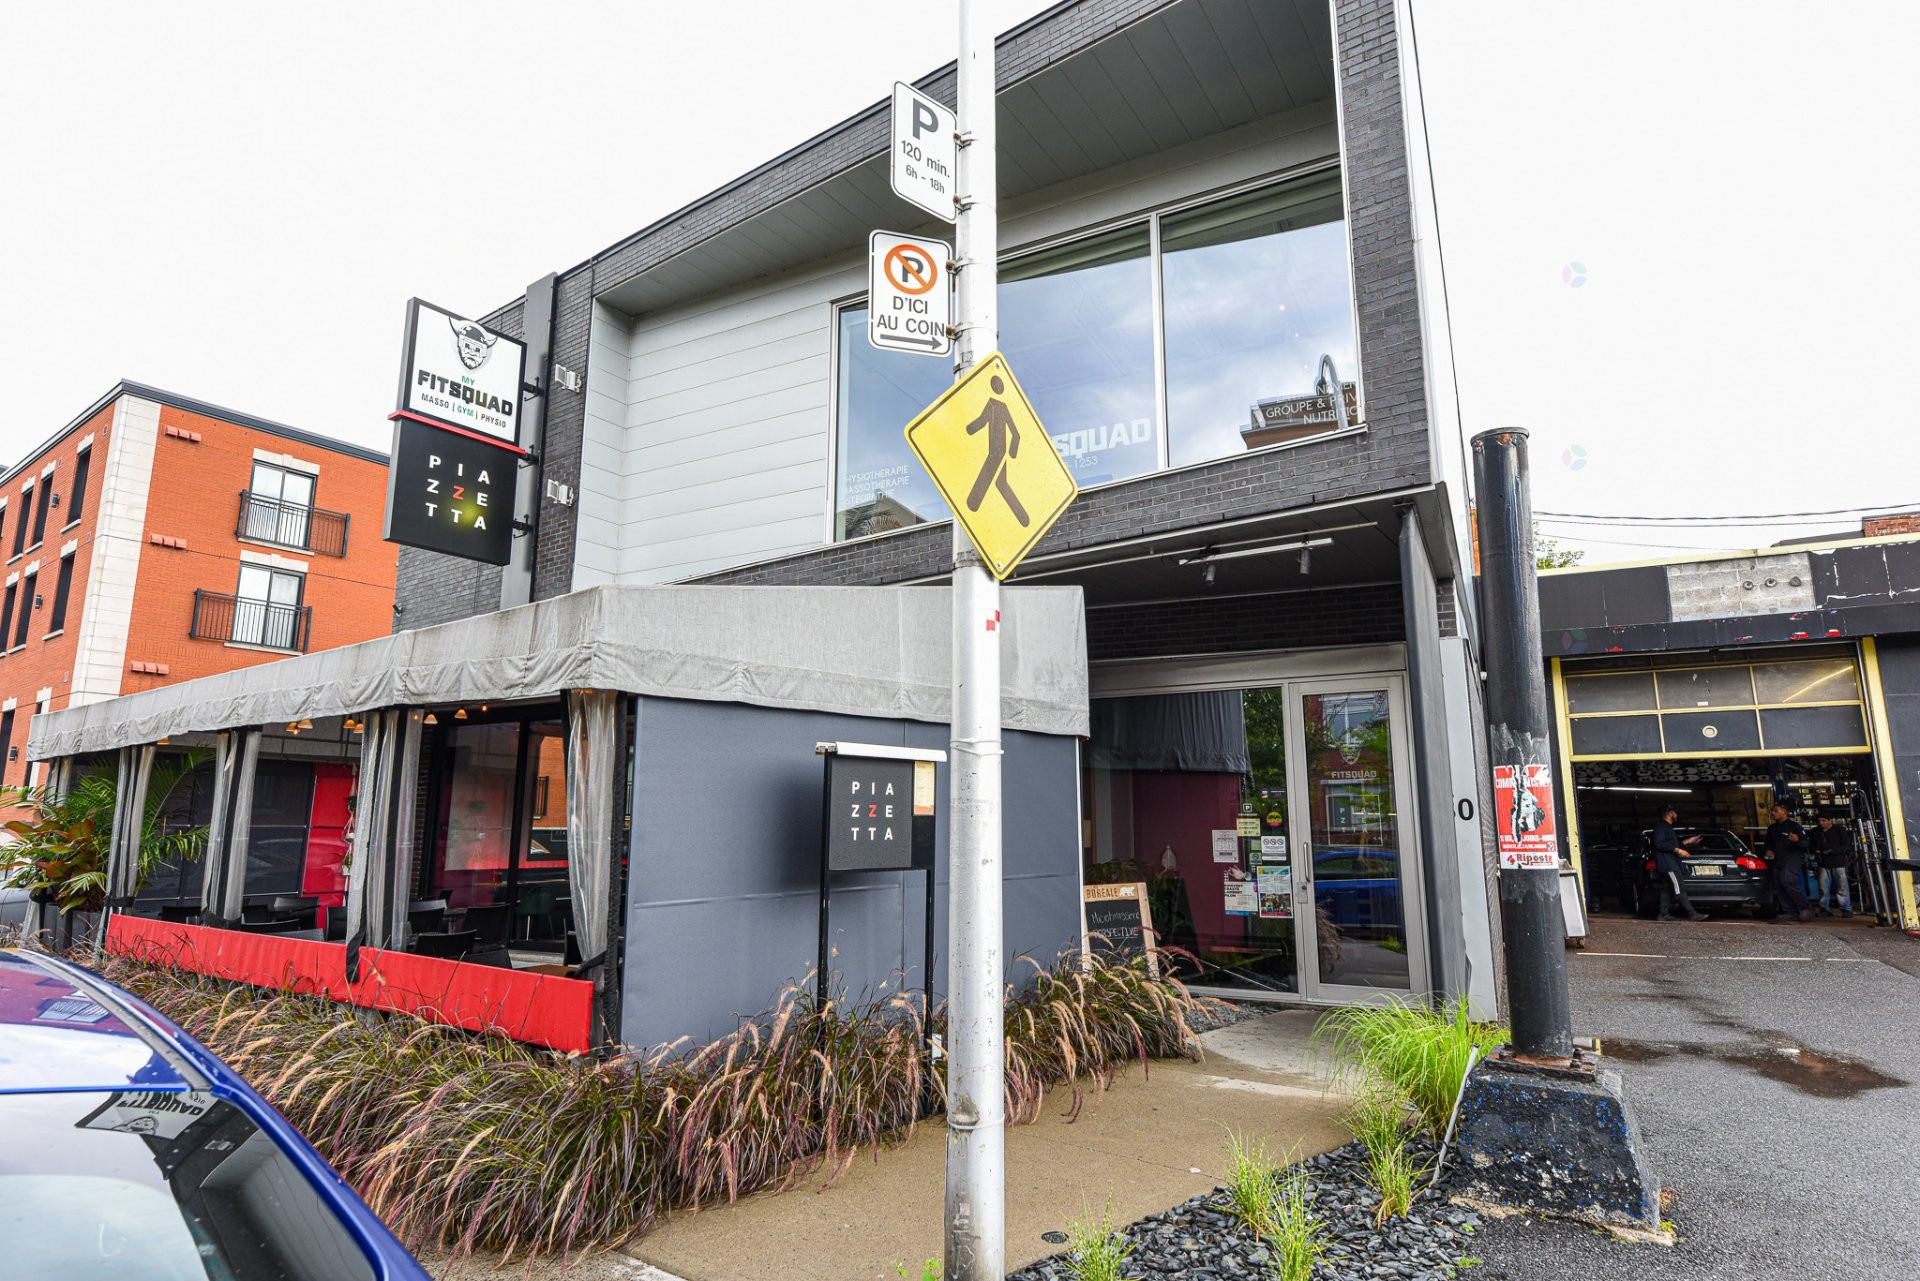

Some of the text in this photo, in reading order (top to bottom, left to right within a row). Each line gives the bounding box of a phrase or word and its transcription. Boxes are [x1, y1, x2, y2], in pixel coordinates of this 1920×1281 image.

[912, 97, 939, 141] P
[901, 139, 950, 178] 120 min.
[905, 164, 918, 180] 6h
[929, 178, 945, 194] 18h
[893, 295, 928, 315] D'ICI
[876, 314, 945, 337] AU COIN
[417, 369, 513, 416] FITSQUAD
[461, 375, 475, 386] MY
[421, 392, 507, 428] MASSO GYM PHYSIO
[1266, 399, 1313, 418] GROUPE
[1317, 398, 1326, 409] &
[1052, 417, 1152, 459] SQUAD
[1331, 770, 1377, 779] FITSQUAD
